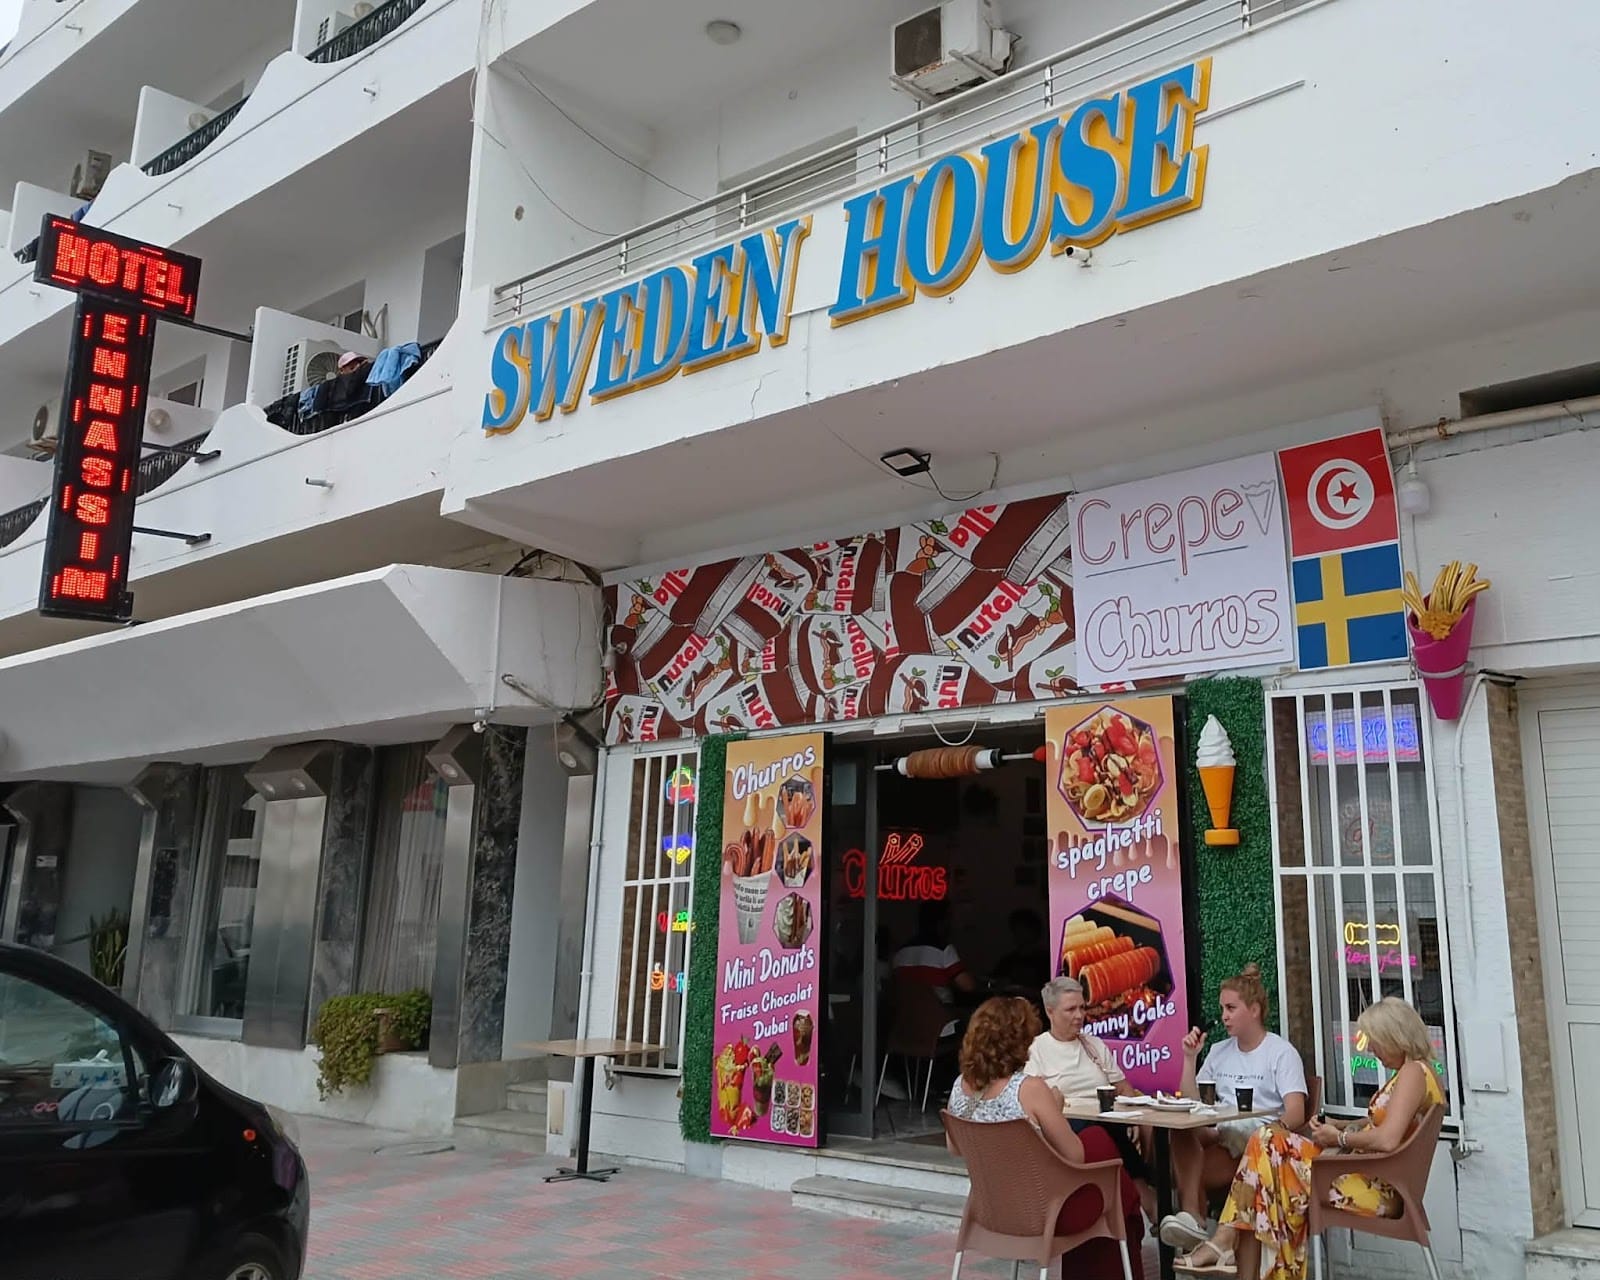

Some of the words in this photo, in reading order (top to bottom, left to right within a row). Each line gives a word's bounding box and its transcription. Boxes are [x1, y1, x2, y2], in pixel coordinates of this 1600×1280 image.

[55, 230, 185, 305] HOTEL
[482, 214, 813, 437] SWEDEN
[829, 56, 1213, 330] HOUSE
[59, 312, 129, 600] ENNASSIM
[1077, 488, 1245, 576] Crepe
[1085, 589, 1280, 673] Churros
[732, 745, 816, 800] Churros
[1056, 808, 1163, 879] spaghetti
[842, 848, 947, 900] Curros
[1087, 864, 1153, 902] crepe
[723, 956, 756, 994] Mini
[759, 943, 815, 984] Donuts
[720, 1001, 759, 1025] Fraise
[761, 982, 814, 1013] Chocolat
[752, 1015, 790, 1041] Dubai
[1081, 1013, 1129, 1040] emny
[1132, 994, 1176, 1025] Cake
[1122, 1043, 1172, 1074] Chips
